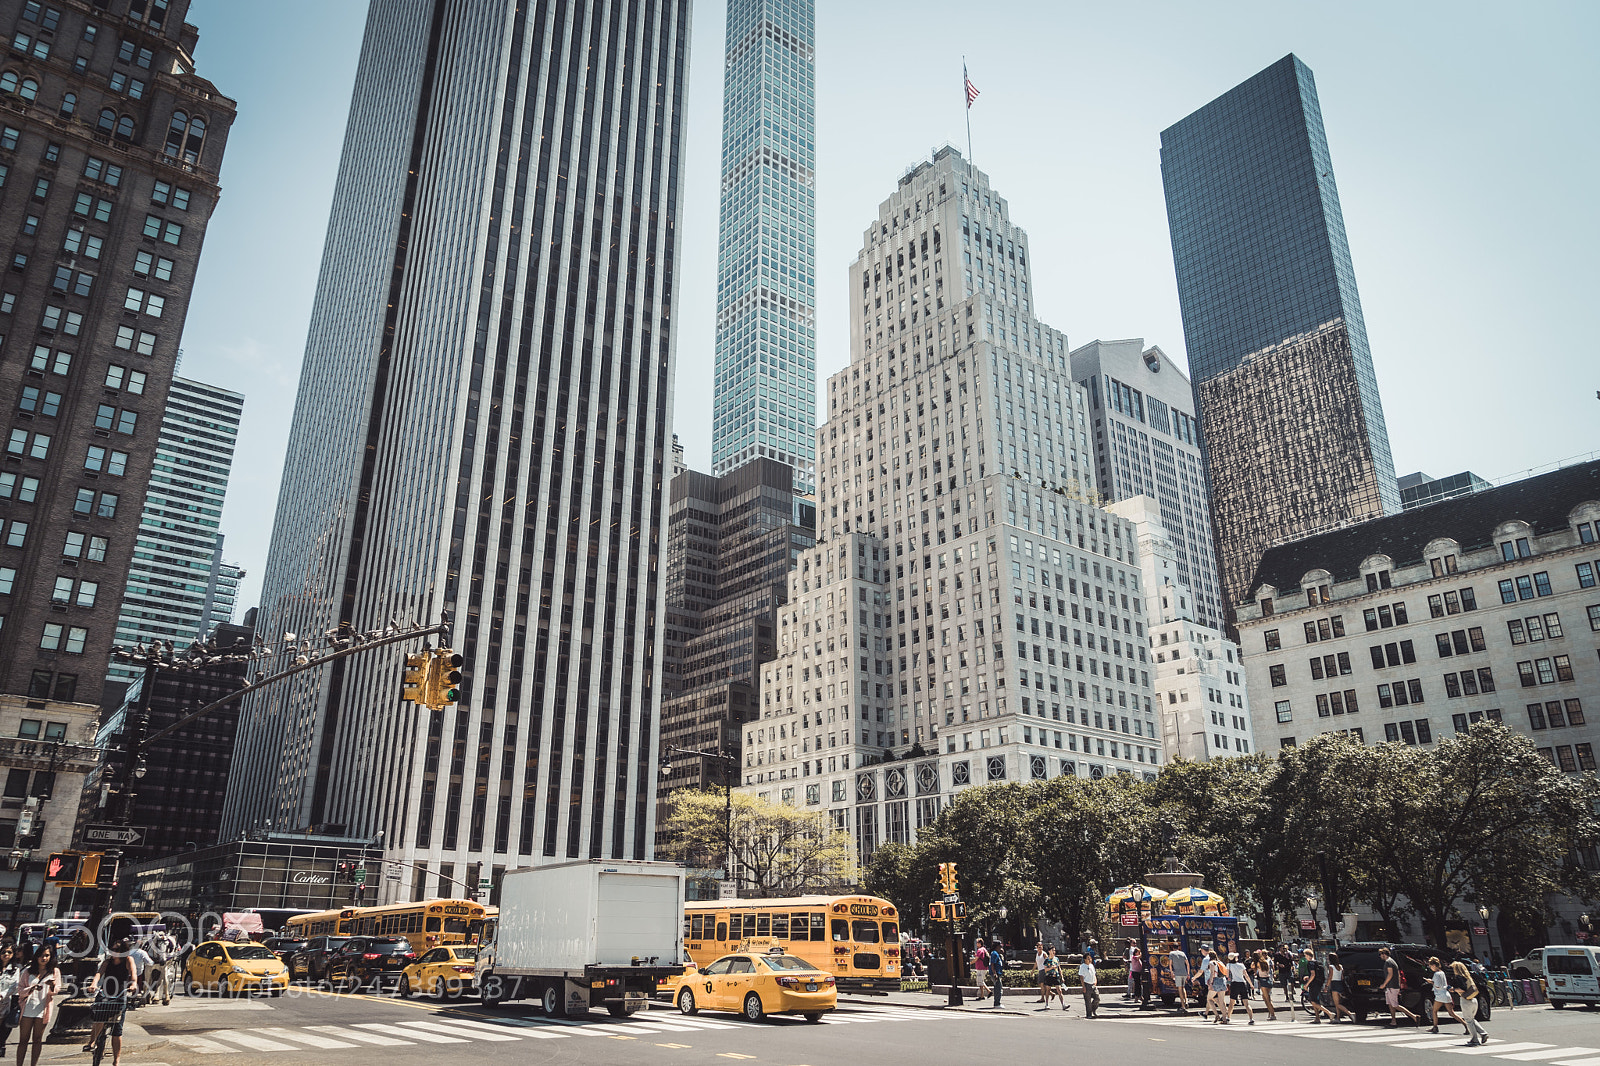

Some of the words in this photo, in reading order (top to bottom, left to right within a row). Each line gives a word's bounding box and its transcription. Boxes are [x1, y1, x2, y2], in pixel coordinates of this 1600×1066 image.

[92, 831, 110, 839] ONE
[118, 832, 136, 840] WAY
[293, 872, 329, 884] Cartier
